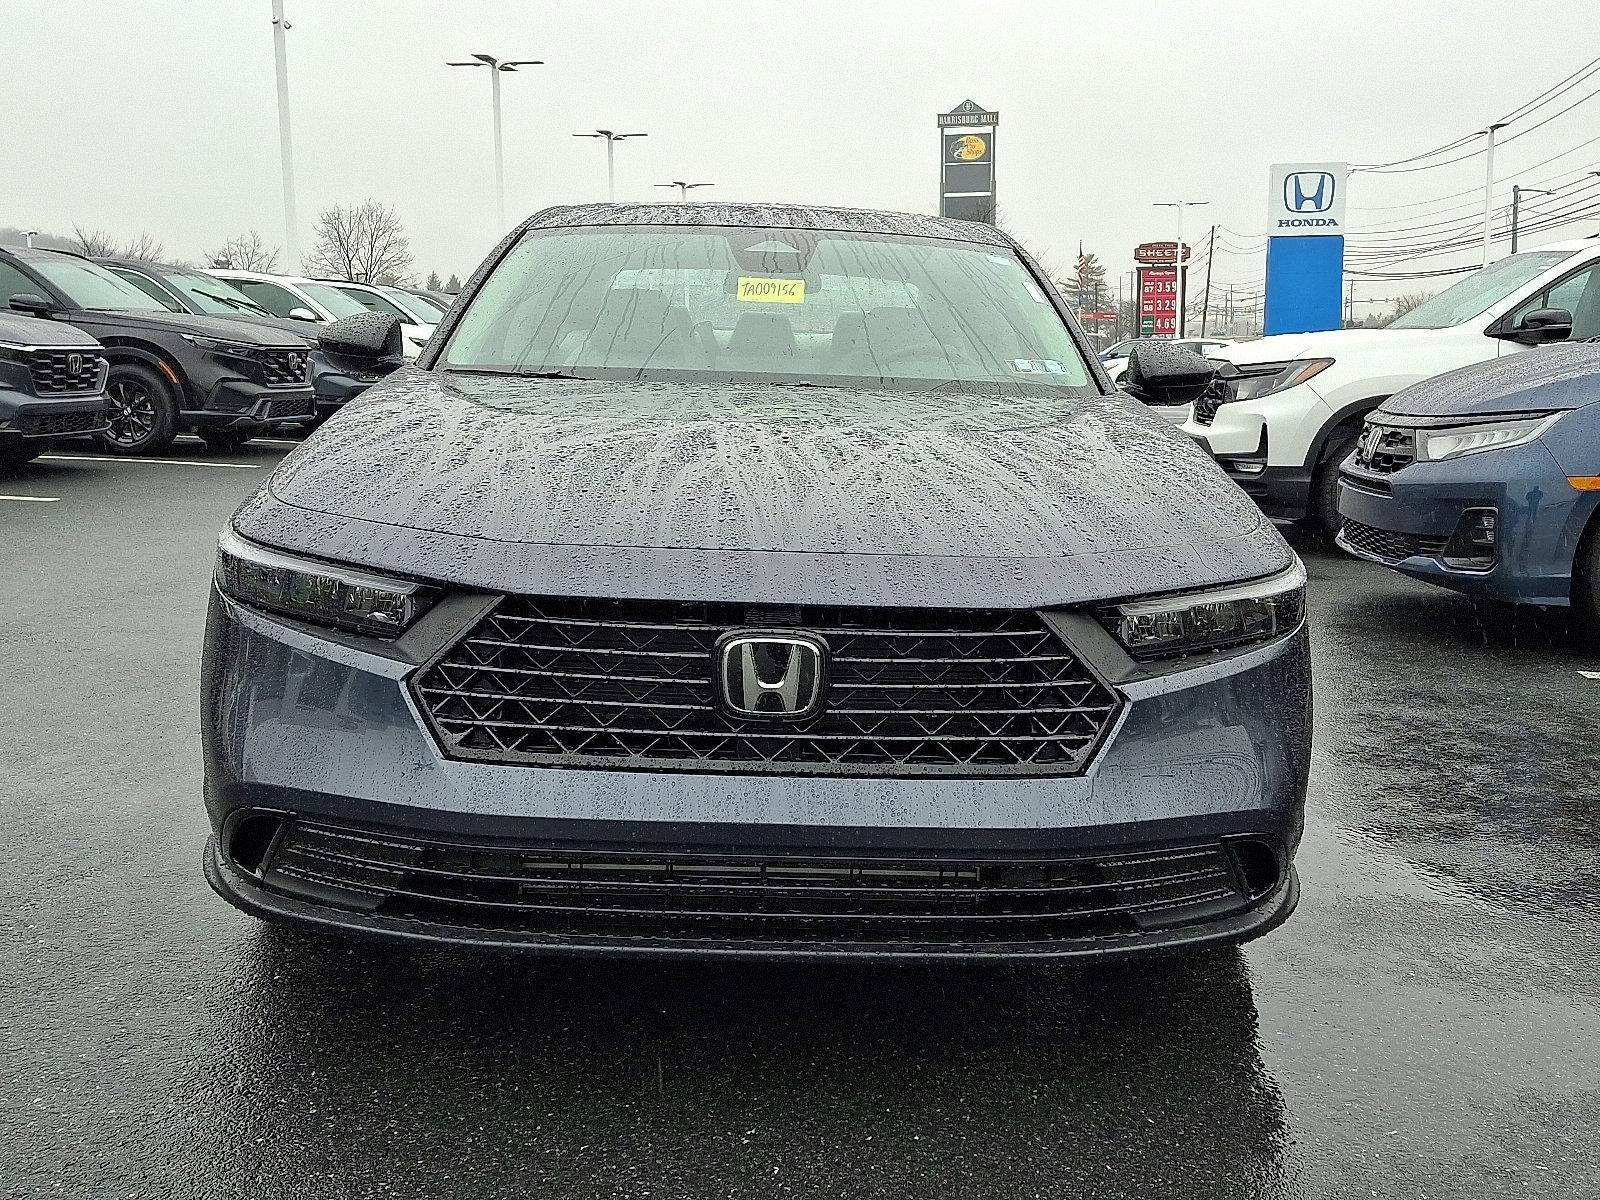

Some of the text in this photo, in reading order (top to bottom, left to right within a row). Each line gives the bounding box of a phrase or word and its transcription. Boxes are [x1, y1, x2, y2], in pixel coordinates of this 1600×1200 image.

[939, 114, 997, 124] HARRISBURG MALL
[1278, 218, 1339, 227] HONDA
[741, 282, 797, 297] TA009156
[1156, 281, 1176, 292] 3.59
[1156, 299, 1175, 310] 3.29
[1155, 318, 1175, 329] 4.69
